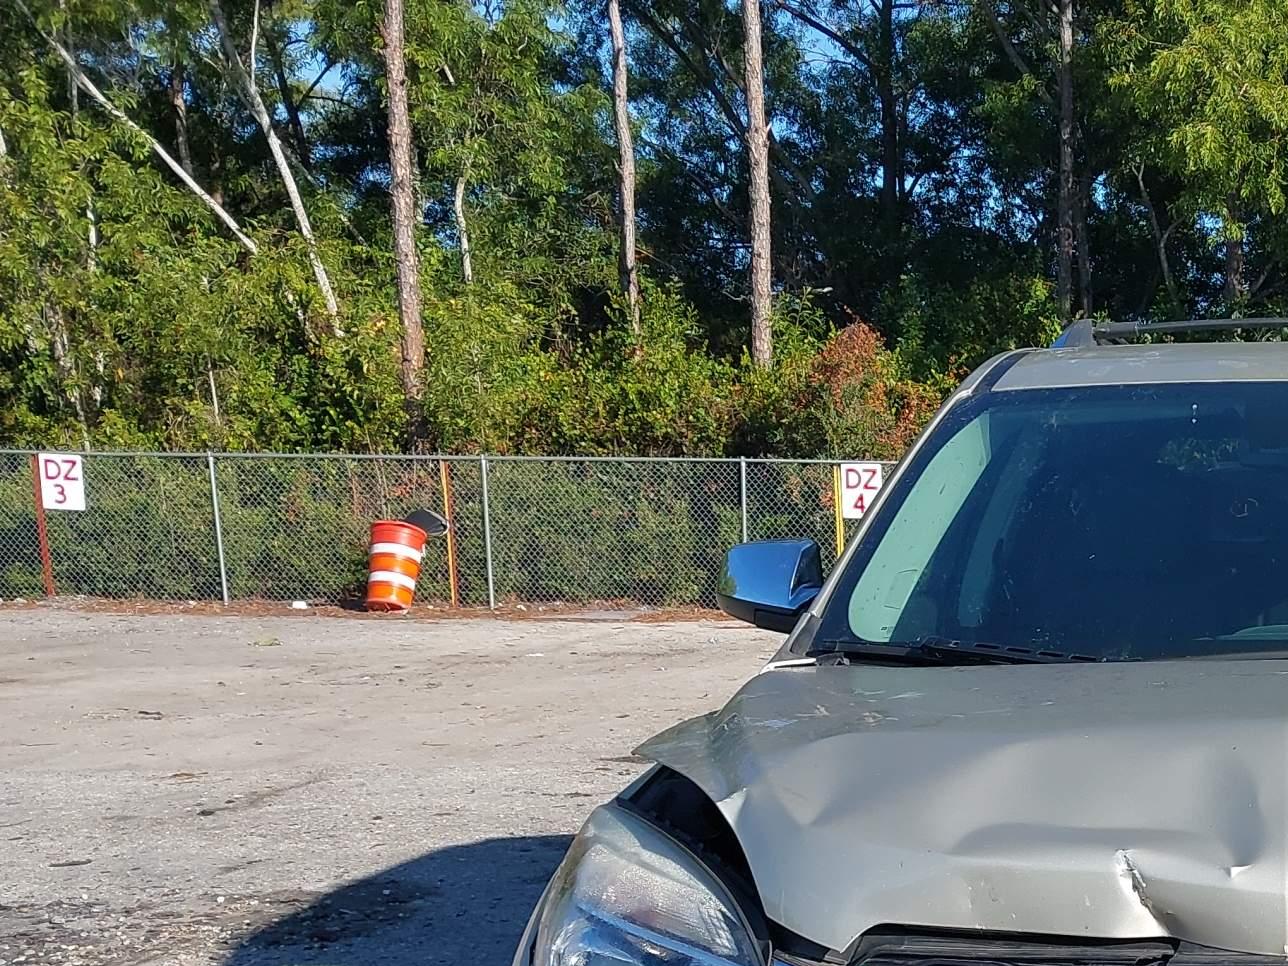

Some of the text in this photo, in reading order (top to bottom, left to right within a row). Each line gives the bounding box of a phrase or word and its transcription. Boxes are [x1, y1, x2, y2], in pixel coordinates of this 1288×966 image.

[44, 458, 79, 481] DZ
[845, 468, 878, 490] DZ
[53, 483, 67, 504] 3
[853, 492, 866, 514] 4
